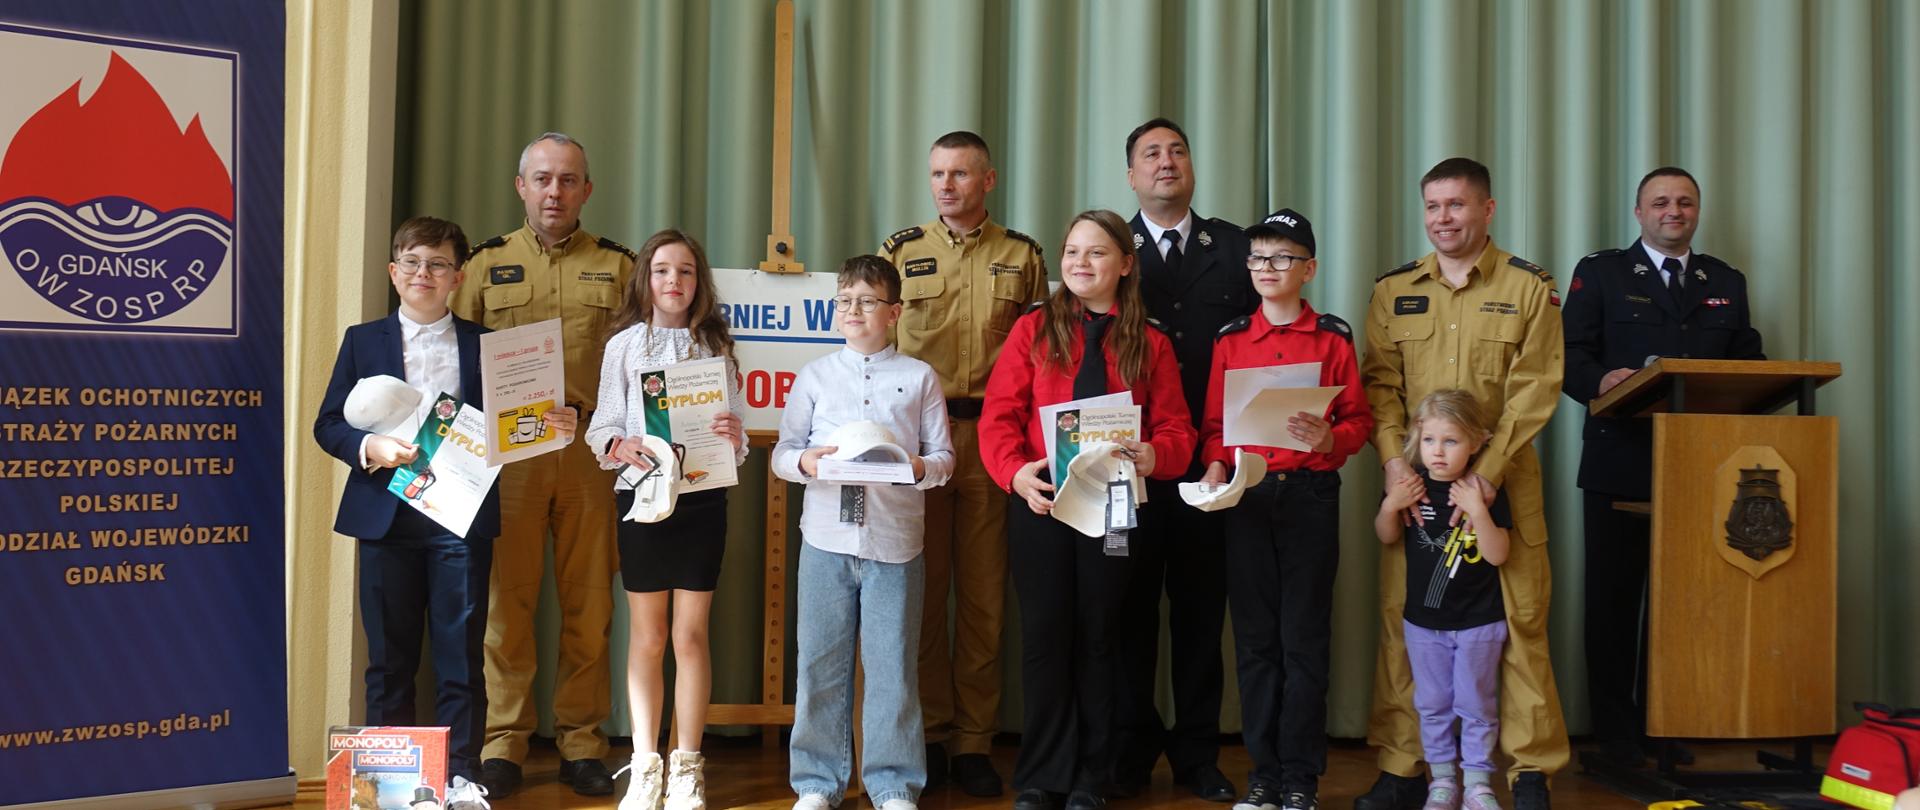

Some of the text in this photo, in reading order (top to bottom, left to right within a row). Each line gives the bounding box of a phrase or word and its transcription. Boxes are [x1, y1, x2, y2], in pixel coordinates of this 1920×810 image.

[58, 252, 168, 280] GDAŃSK
[70, 288, 166, 319] ZOSP
[171, 258, 208, 300] RP
[0, 387, 263, 410] ĄZEK OCHOTNICZYCH
[658, 389, 723, 410] DYPLOM
[0, 420, 238, 441] TRAŻY POŻARNYCH
[1070, 429, 1136, 443] DYPLOM
[60, 493, 179, 513] POLSKIEJ
[91, 522, 249, 549] WOJEWÓDZKI
[65, 561, 166, 585] GDAŃSK
[333, 737, 408, 749] MONOPOLY
[359, 755, 414, 766] MONOPOLY
